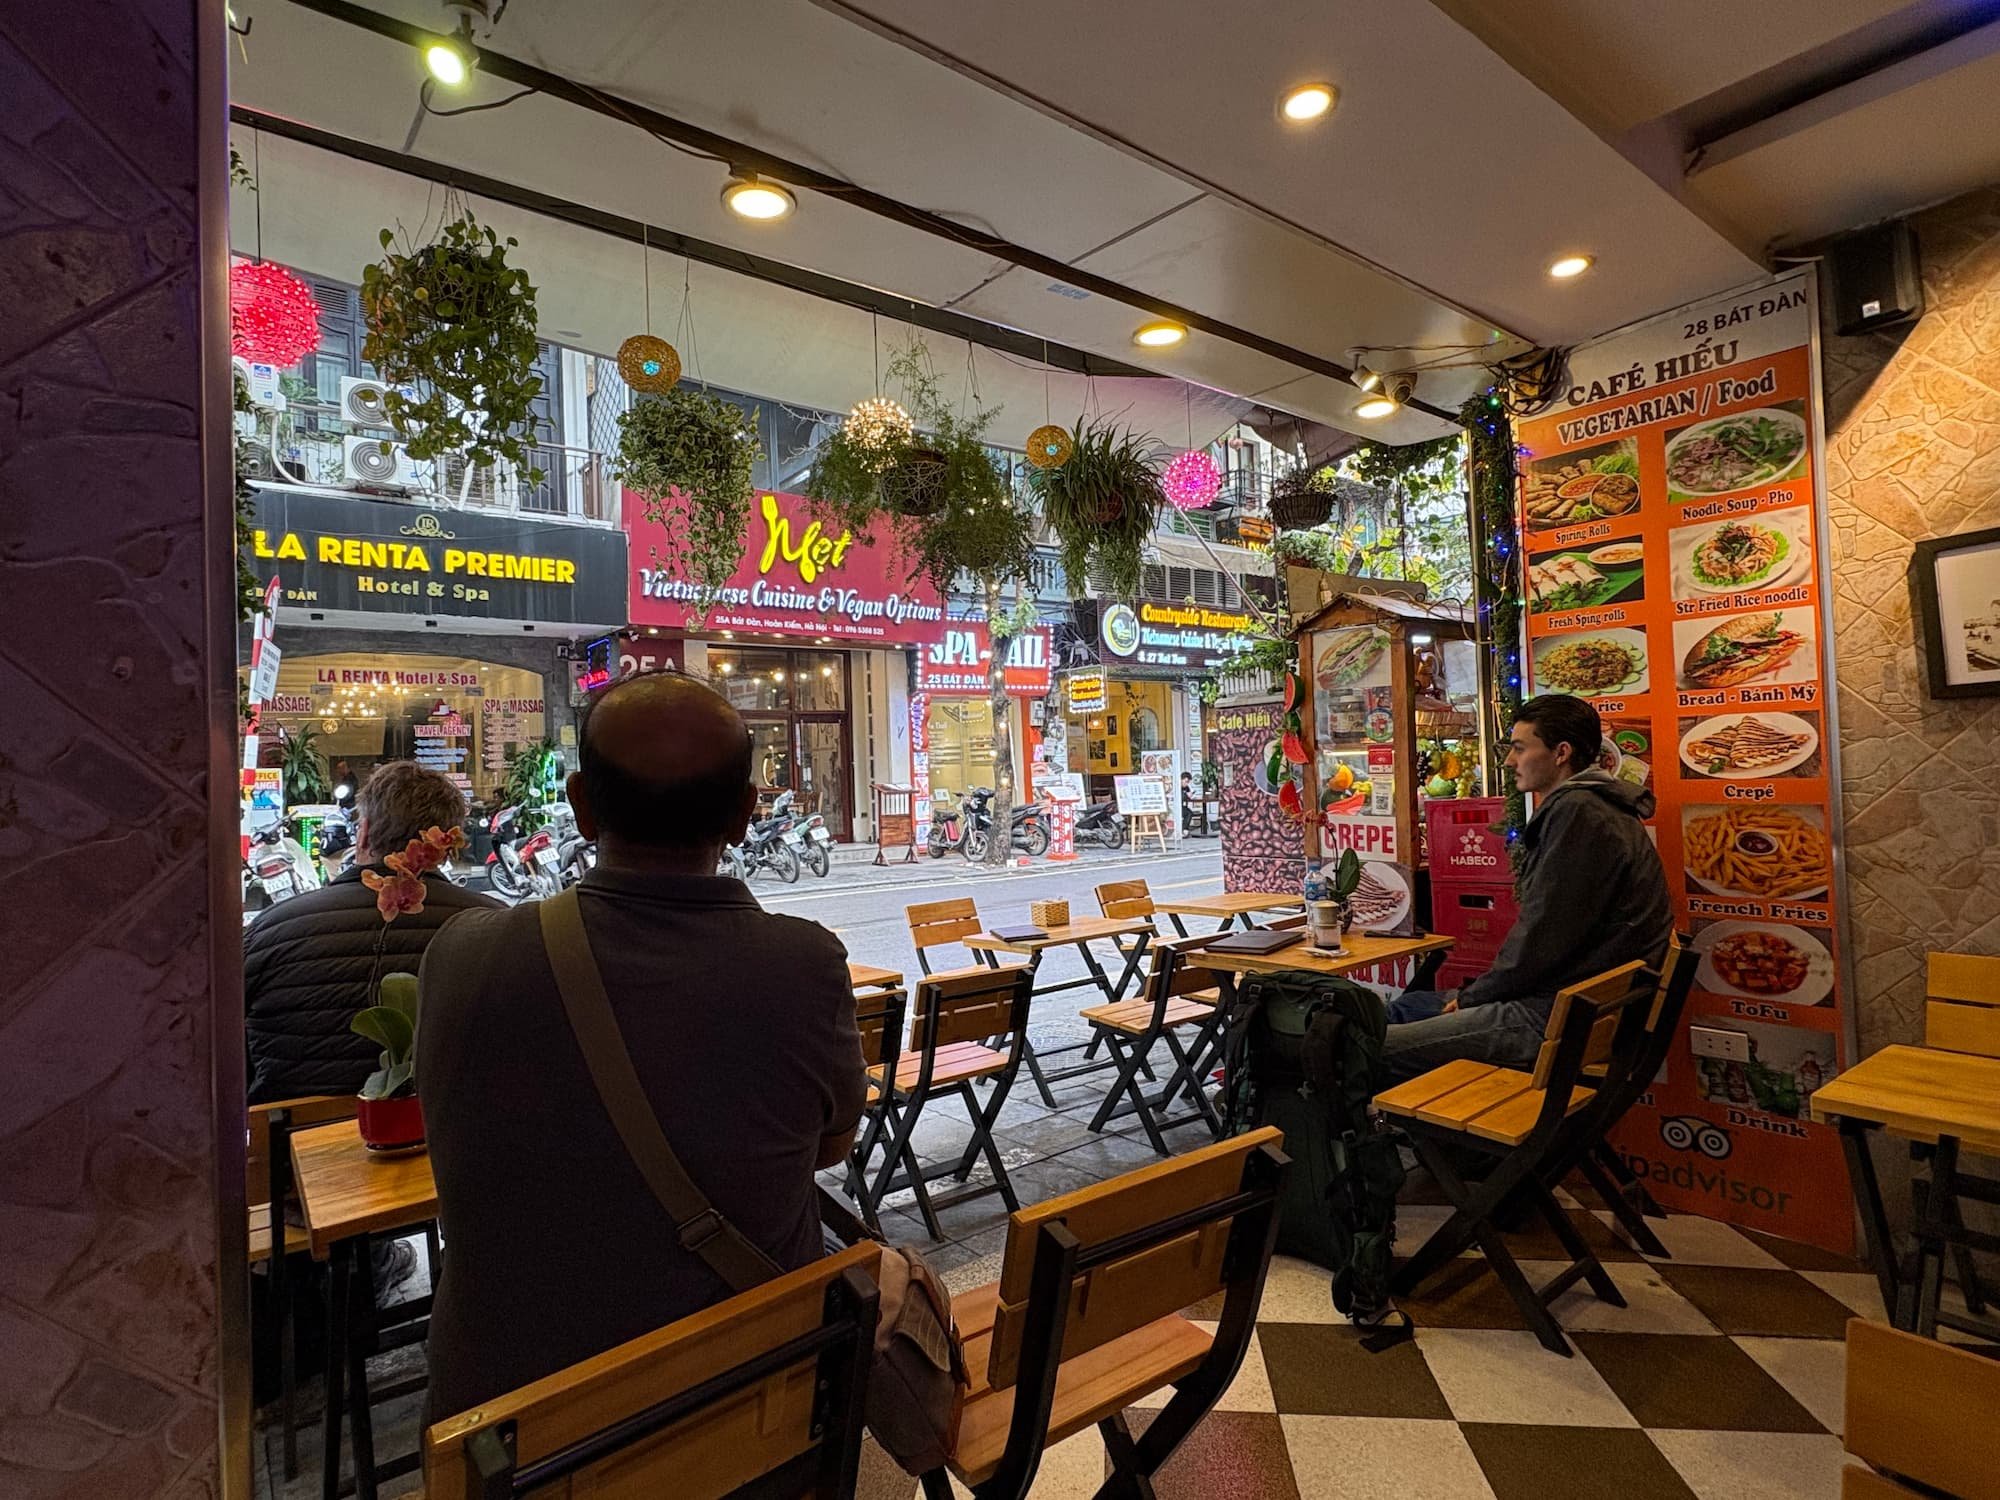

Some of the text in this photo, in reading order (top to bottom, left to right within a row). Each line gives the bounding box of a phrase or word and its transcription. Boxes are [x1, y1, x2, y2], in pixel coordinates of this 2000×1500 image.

[1684, 289, 1807, 339] 28 BÁT ĐÀN
[1568, 337, 1739, 407] CAFÉ HIẾU
[1559, 369, 1774, 443] VEGETARIAN / Food
[1682, 504, 1724, 519] Noodle
[1727, 498, 1757, 514] Soup
[1769, 490, 1793, 504] Pho
[1588, 524, 1610, 539] Rolls
[255, 530, 576, 584] LA RENTA PREMIER
[287, 588, 318, 601] ĐÀN
[358, 575, 490, 602] Hotel & Spa
[752, 581, 815, 611] Cuisine
[818, 588, 835, 612] &
[835, 589, 884, 622] Vegan
[886, 594, 942, 625] Options
[1677, 588, 1808, 614] Str Fried Rice noodle
[715, 616, 731, 624] 25A
[1141, 603, 1200, 627] Countryside
[1549, 616, 1573, 628] Fresh
[1603, 609, 1625, 622] rolls
[1004, 635, 1047, 667] AIL
[318, 669, 477, 686] LA RENTA Hotel & Spa
[928, 673, 985, 684] 25 BÁT ĐÀN
[262, 697, 311, 711] MASSAGE
[485, 699, 502, 713] SPA
[1598, 701, 1624, 711] rice
[1679, 691, 1725, 706] Bread
[1740, 687, 1784, 703] Bánh
[1791, 685, 1816, 703] Mỳ
[415, 725, 471, 736] TRAVEL AGENCY
[1724, 785, 1774, 800] Crepé
[1063, 805, 1071, 853] SPA
[1325, 823, 1395, 854] CREPE
[1450, 856, 1497, 866] HABECO
[1689, 900, 1827, 921] French Fries
[1732, 1001, 1787, 1019] ToFu
[1728, 1110, 1808, 1139] Drink
